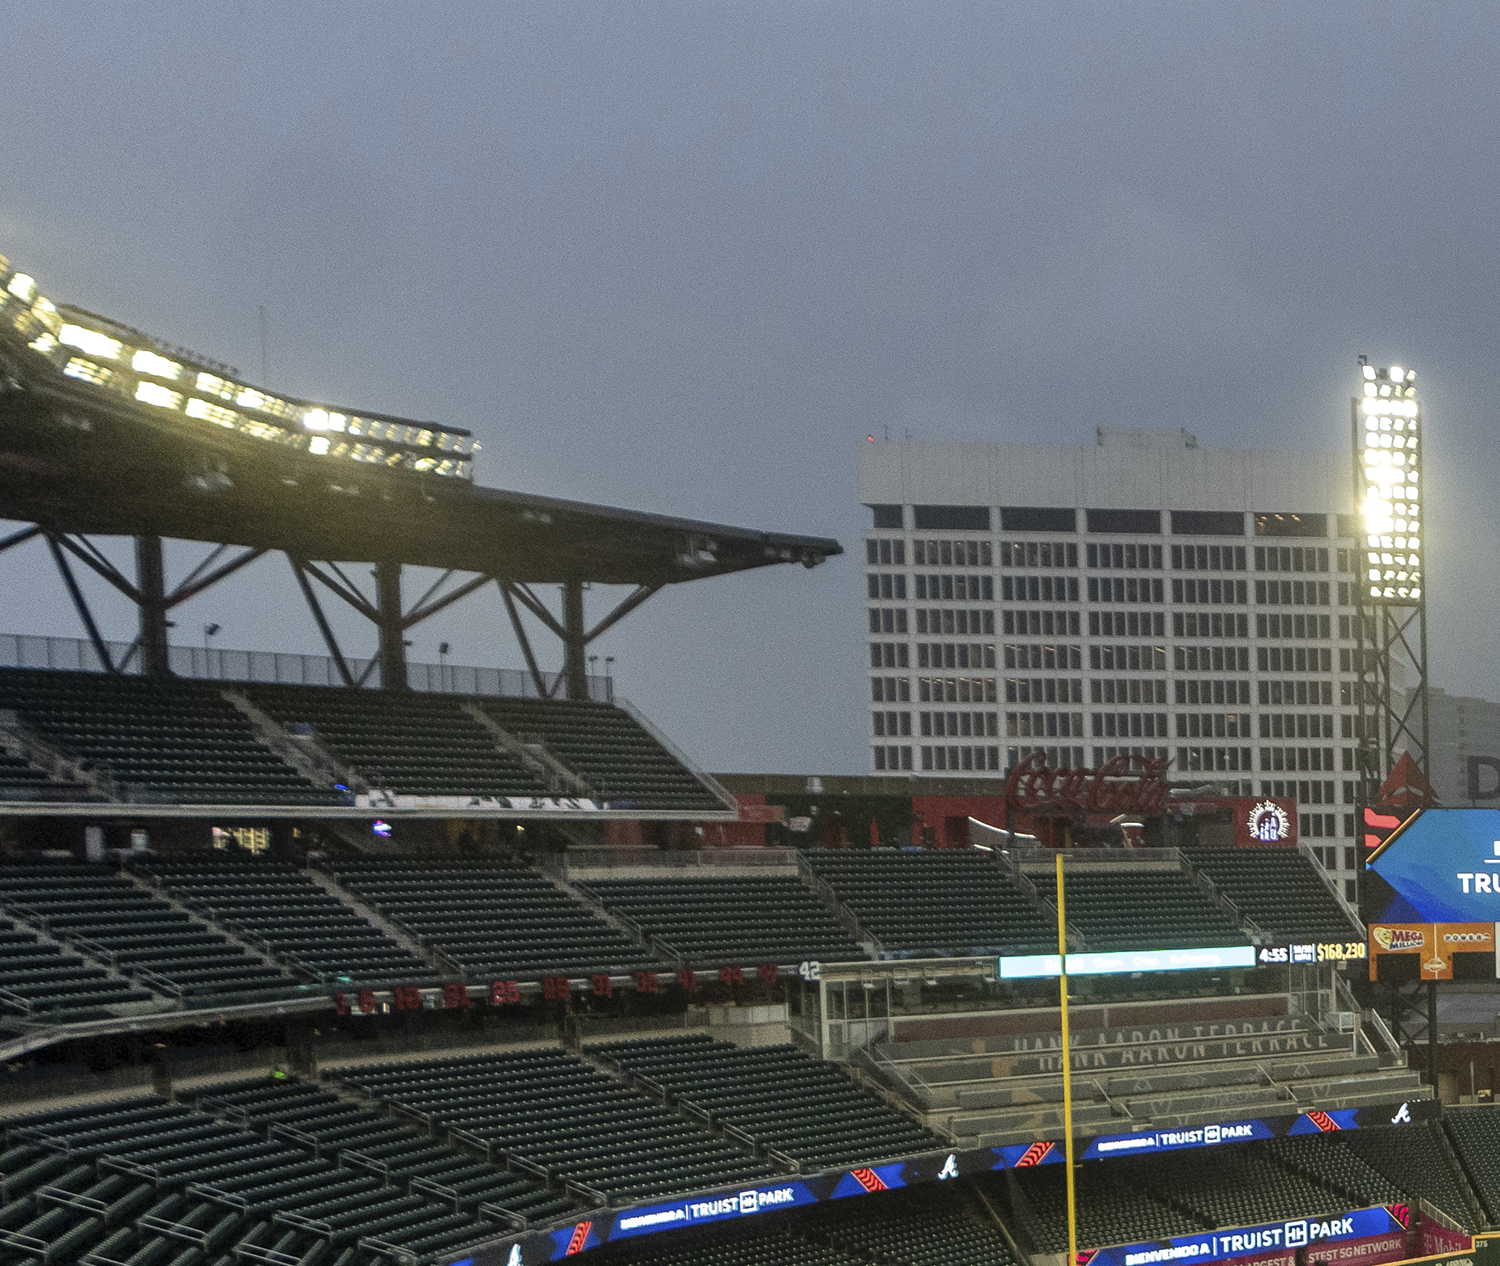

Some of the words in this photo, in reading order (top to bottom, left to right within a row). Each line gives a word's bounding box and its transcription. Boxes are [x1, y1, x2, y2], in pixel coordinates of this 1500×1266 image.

[1391, 929, 1424, 942] MEGA
[1259, 947, 1288, 962] 4:55
[1316, 941, 1366, 962] $168,230
[1097, 1137, 1147, 1152] BIENVENIDO
[1160, 1128, 1203, 1146] TRUIST
[1220, 1123, 1253, 1139] PARK
[1125, 1242, 1199, 1266] BIENVENIDO
[1199, 1241, 1211, 1256] A
[1219, 1227, 1283, 1253] TRUIST
[1309, 1217, 1354, 1238] PARK
[1476, 1240, 1488, 1249] 375
